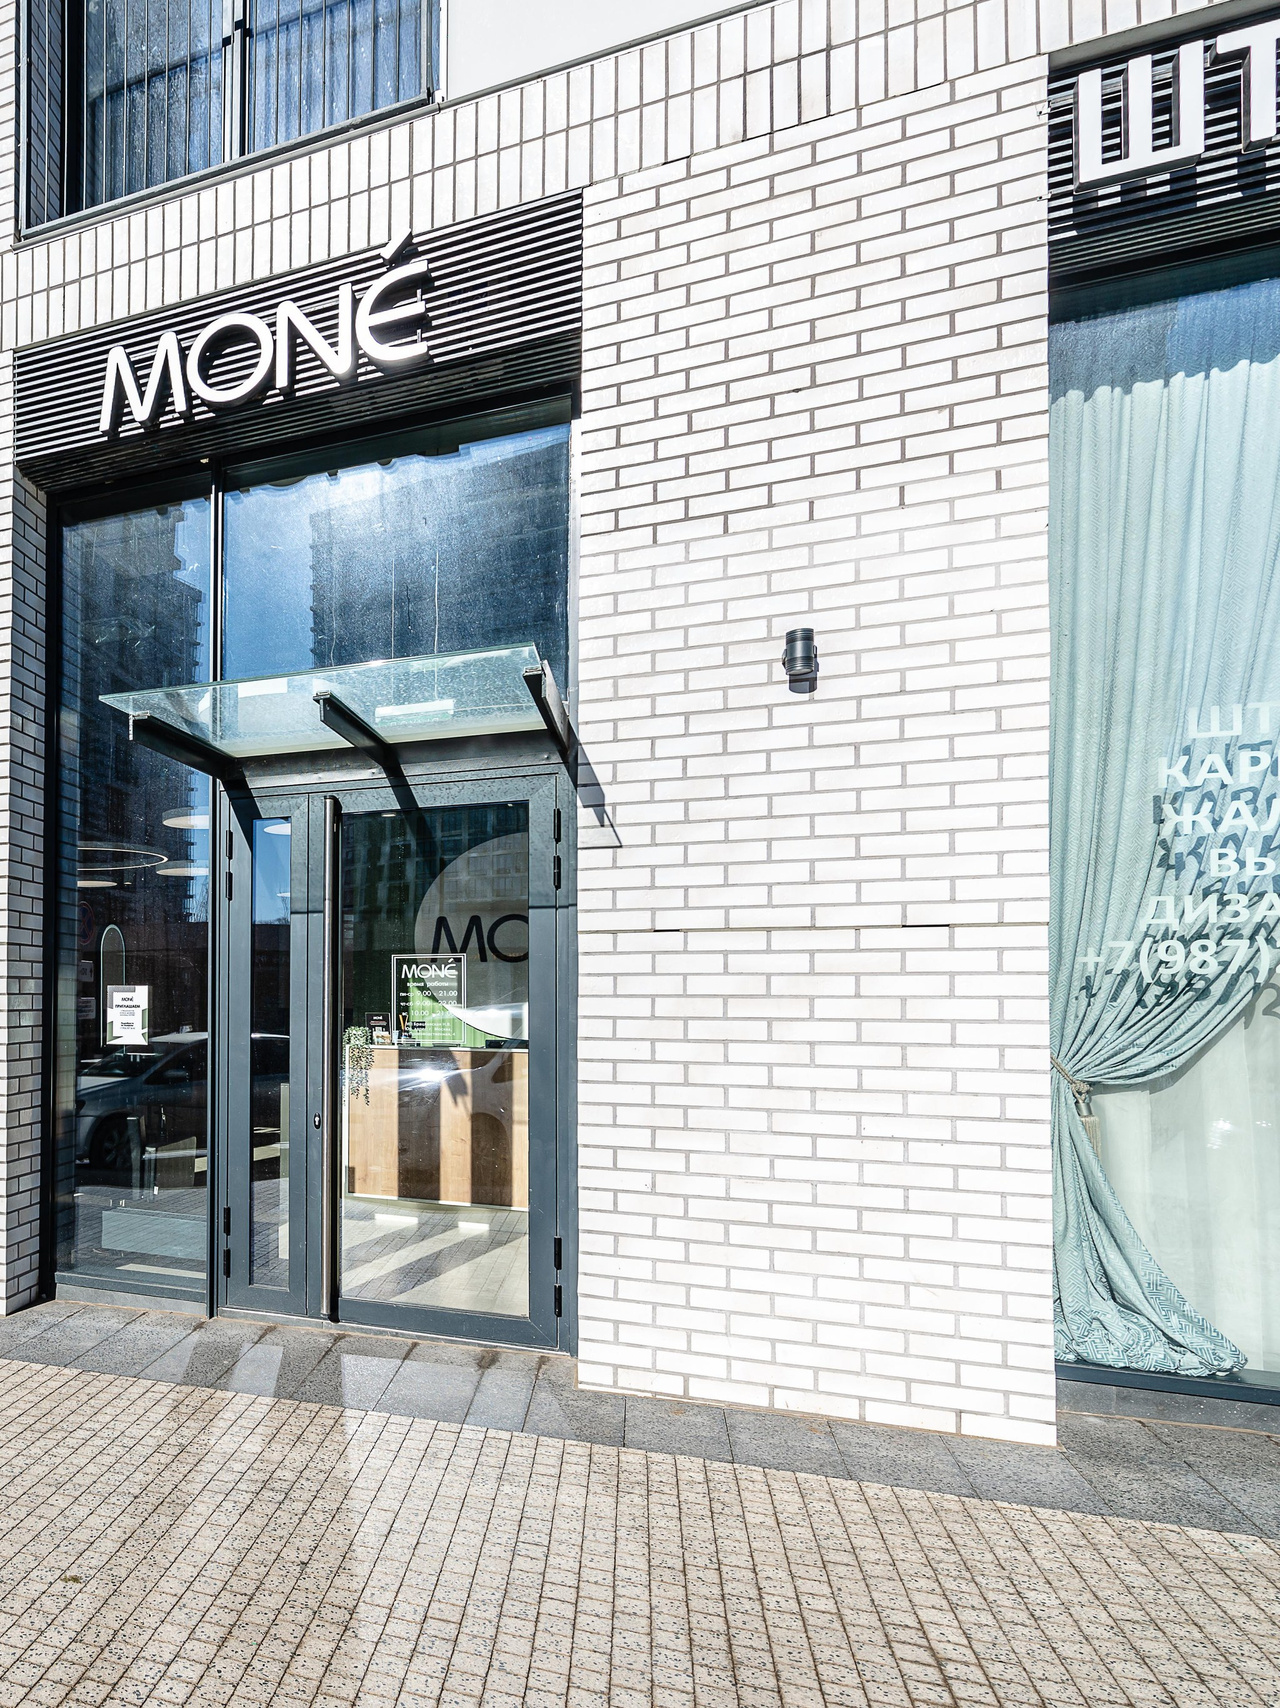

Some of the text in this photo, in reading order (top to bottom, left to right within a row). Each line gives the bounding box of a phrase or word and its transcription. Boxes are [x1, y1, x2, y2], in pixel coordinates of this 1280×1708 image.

[99, 228, 429, 435] MONÉ
[1158, 750, 1280, 789] КАР
[401, 957, 458, 979] MONÉ
[1076, 935, 1280, 984] +7(987)
